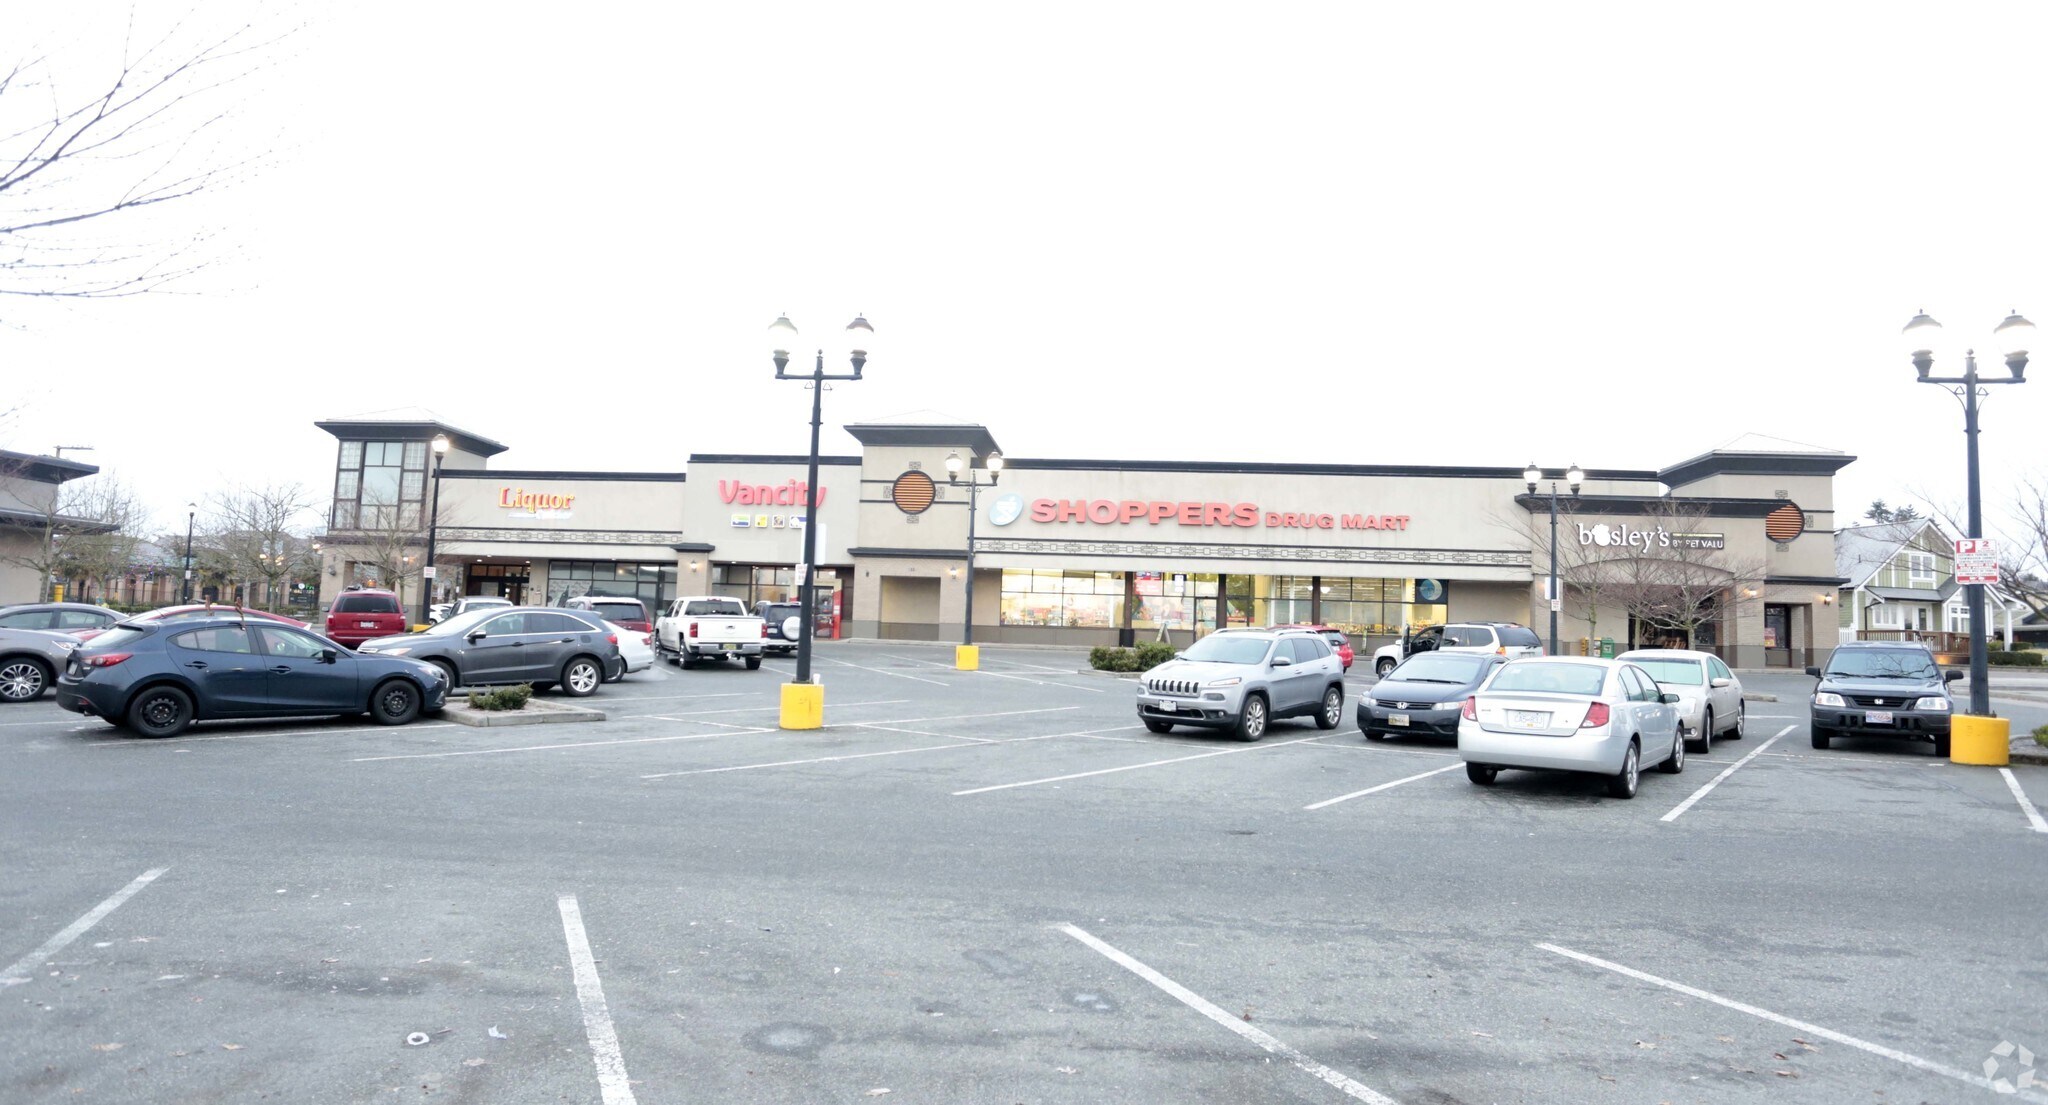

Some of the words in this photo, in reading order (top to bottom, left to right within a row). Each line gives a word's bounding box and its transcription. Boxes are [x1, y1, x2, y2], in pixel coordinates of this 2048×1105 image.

[498, 487, 575, 513] Liquor
[1030, 498, 1259, 528] SHOPPERS
[1266, 511, 1334, 529] DRUG
[1341, 514, 1410, 531] MART
[1959, 540, 1973, 553] P
